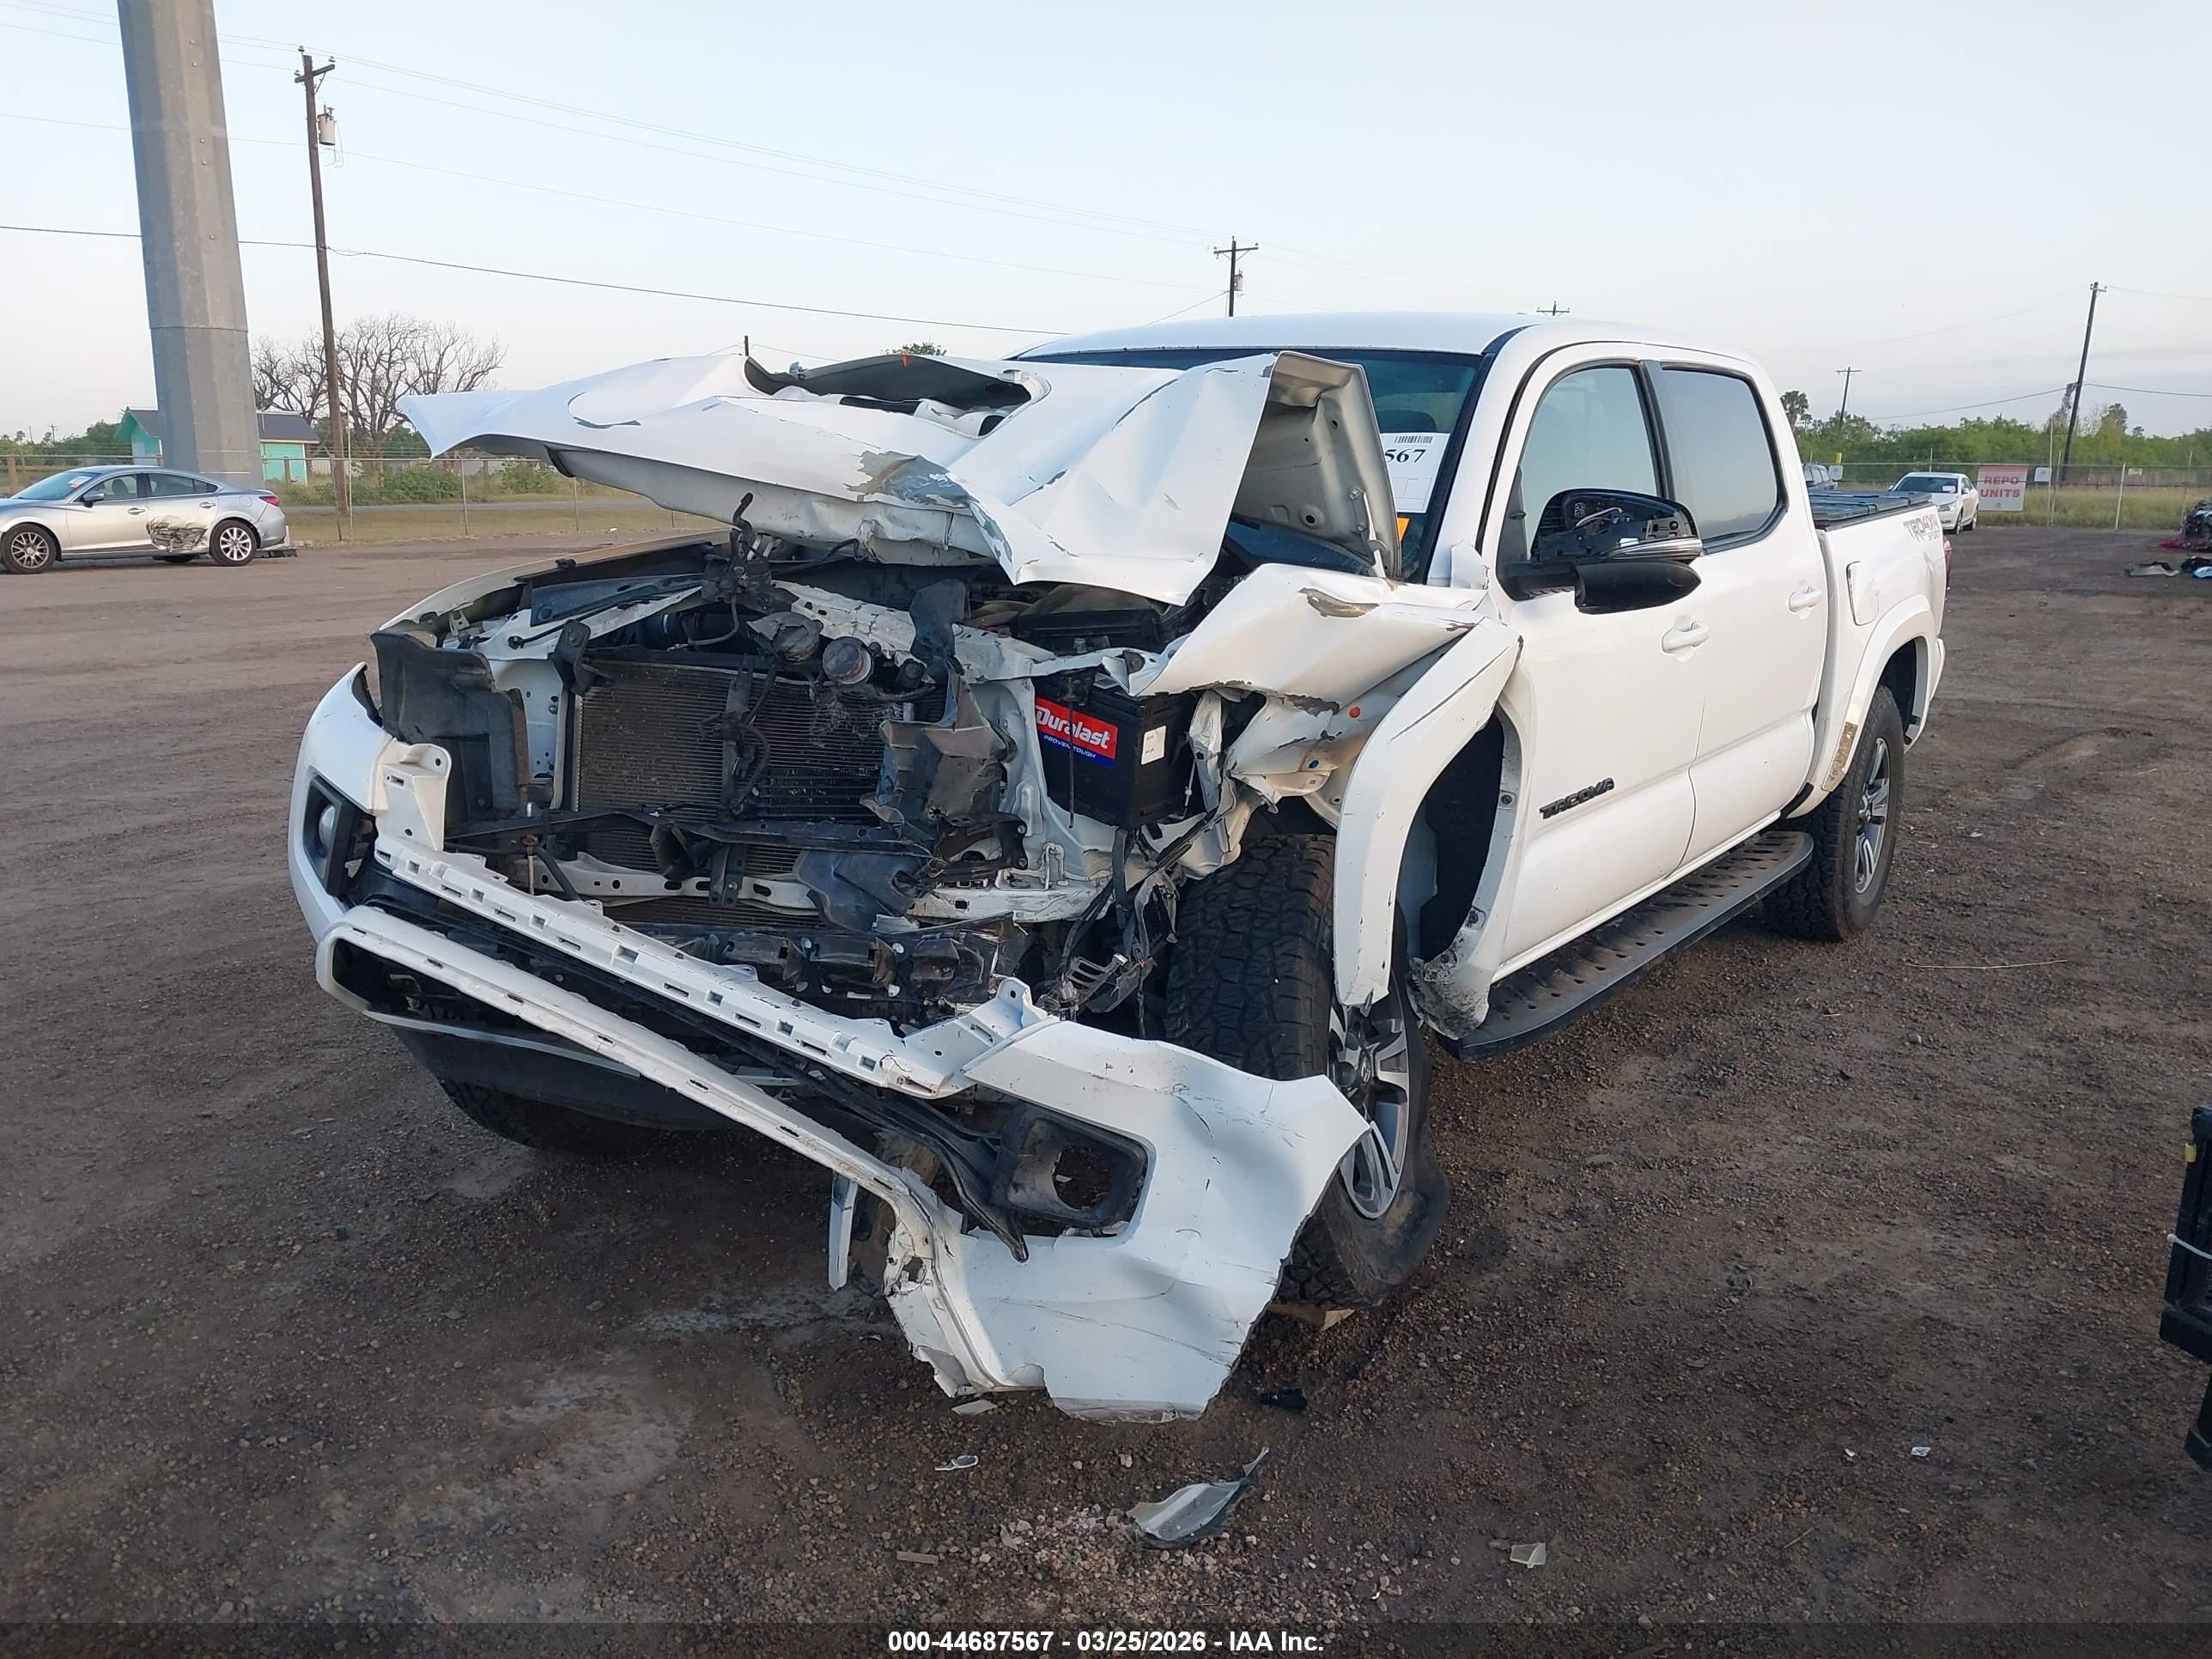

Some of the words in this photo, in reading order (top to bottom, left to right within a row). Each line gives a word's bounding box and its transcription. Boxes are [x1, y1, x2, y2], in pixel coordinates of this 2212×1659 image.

[1385, 448, 1426, 463] 567
[1984, 476, 2020, 485] REPO
[1980, 489, 2021, 498] UNITS
[1036, 705, 1110, 749] Duralast
[1043, 734, 1071, 750] PROVEN
[1073, 746, 1097, 758] TOUGH
[1539, 777, 1614, 819] TACOMA
